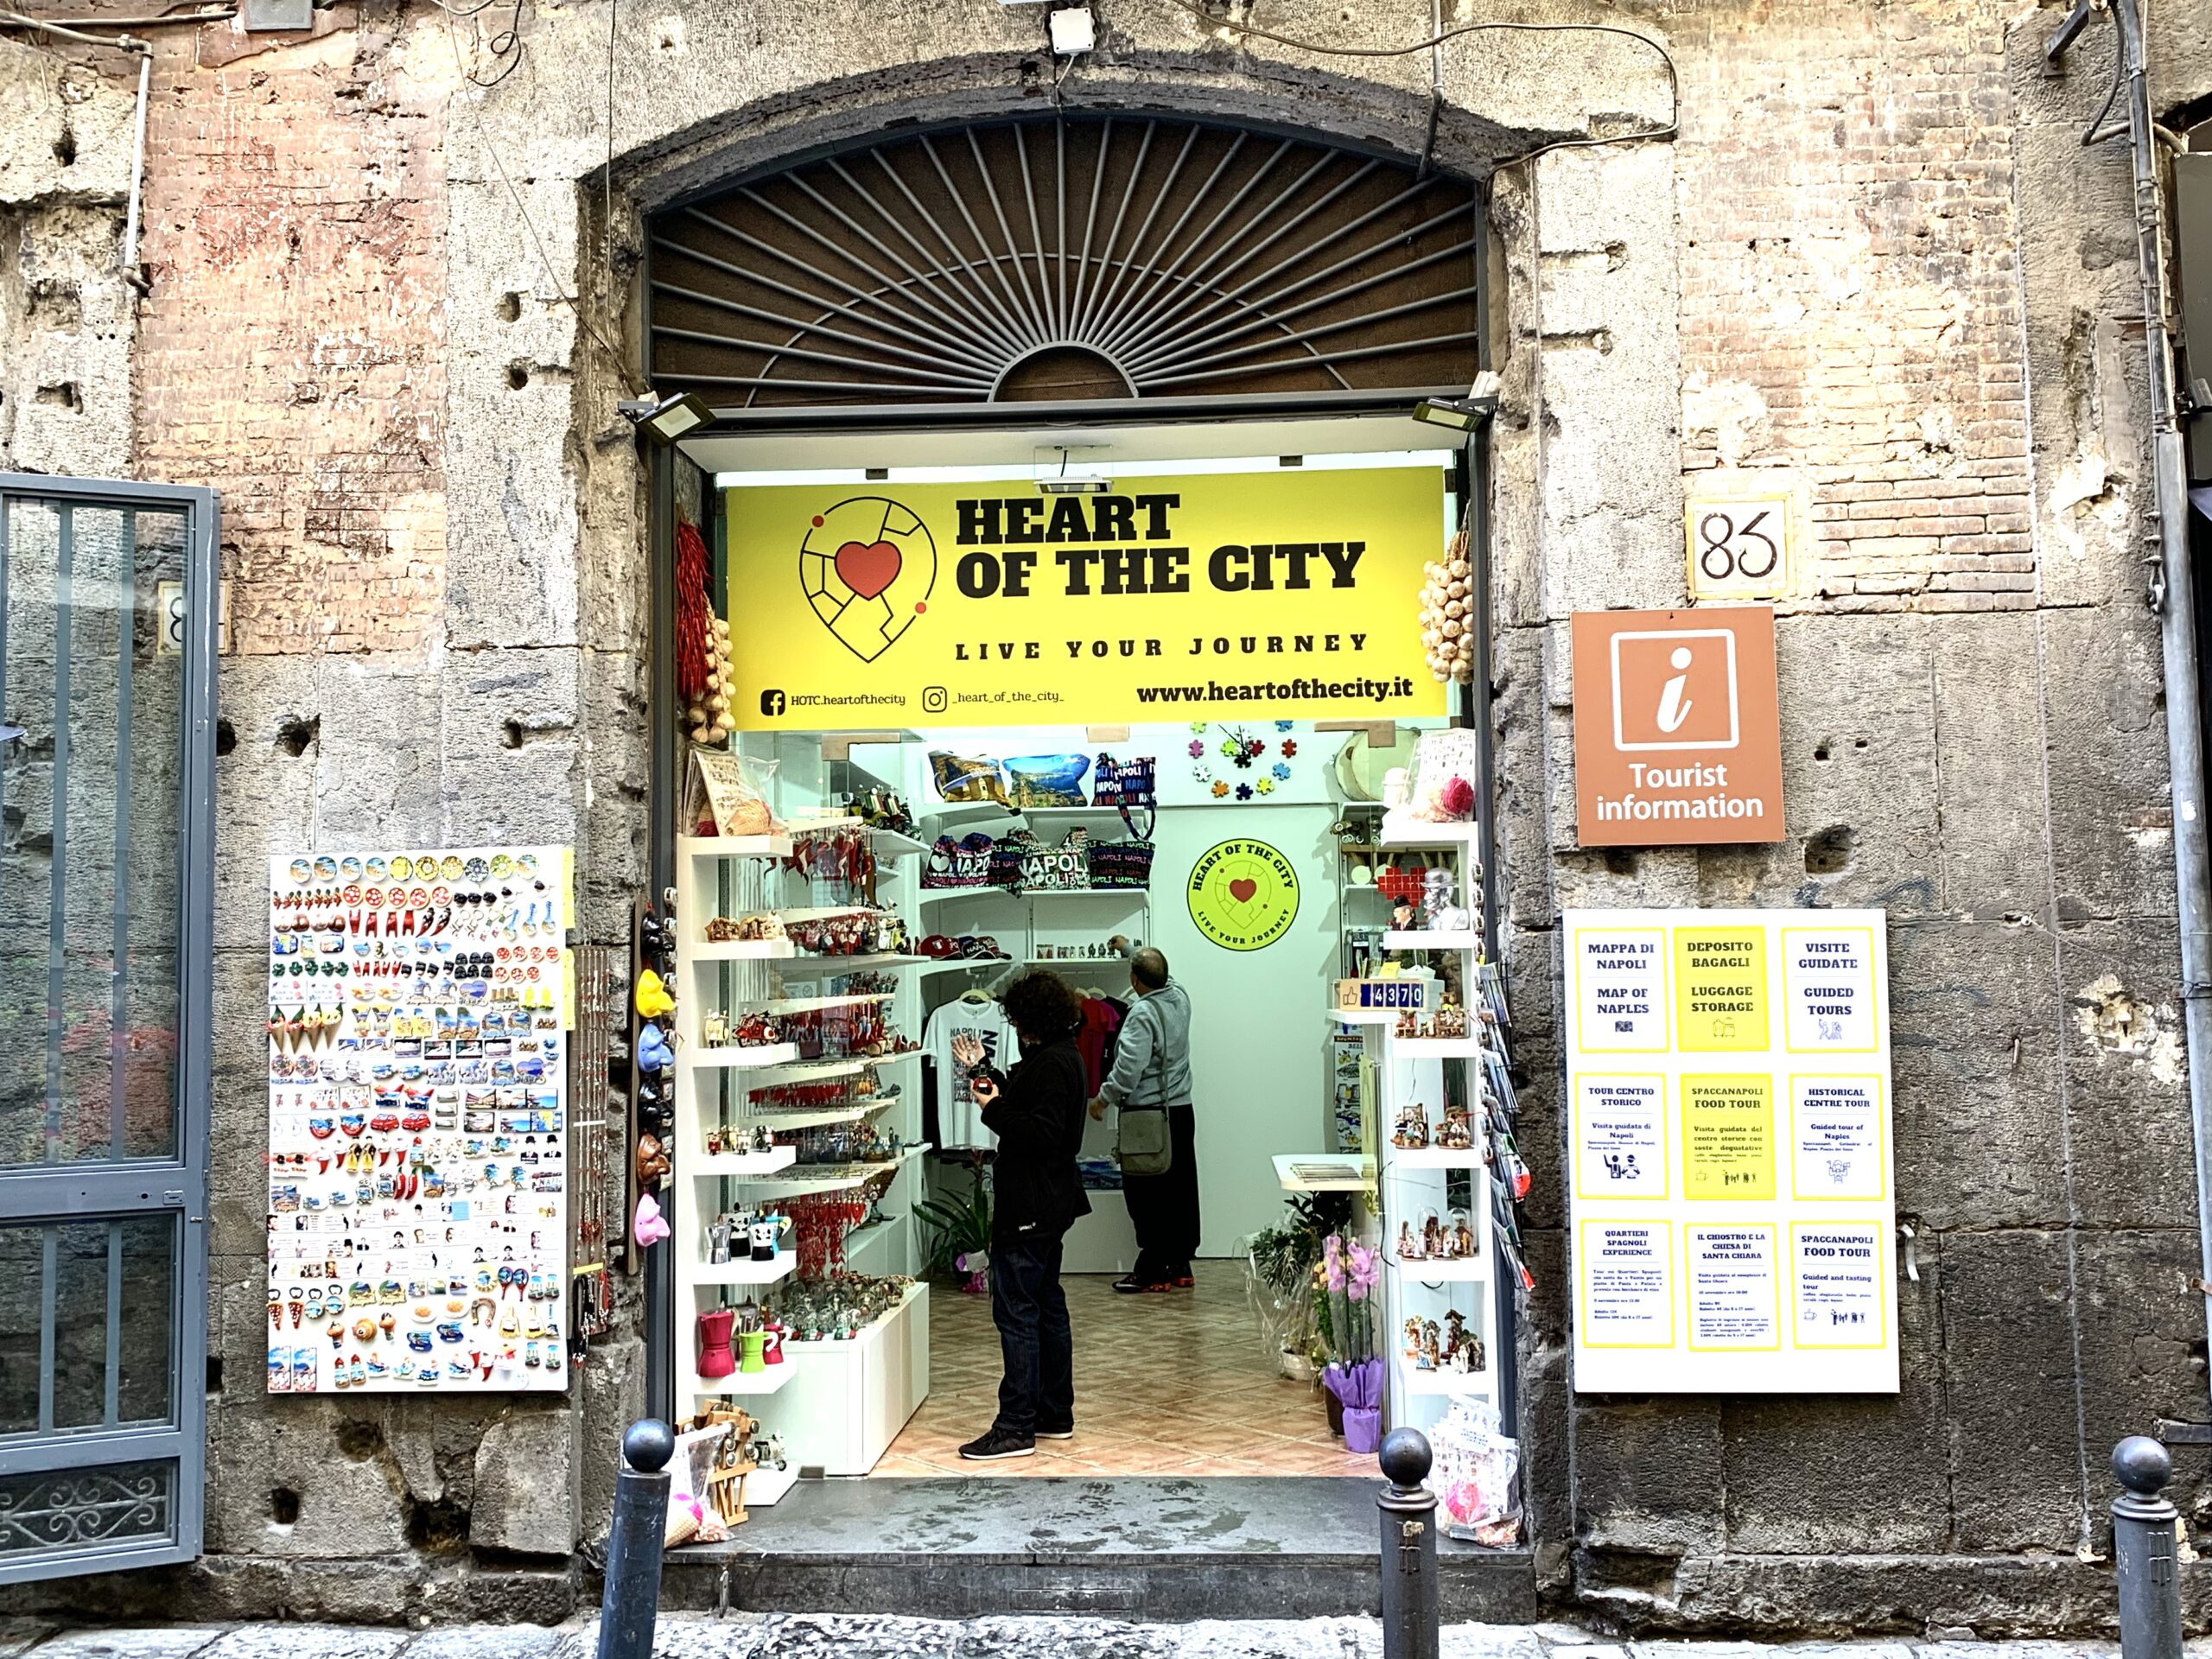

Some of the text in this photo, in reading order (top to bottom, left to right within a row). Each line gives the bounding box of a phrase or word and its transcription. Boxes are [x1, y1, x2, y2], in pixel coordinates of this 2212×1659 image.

[957, 493, 1180, 544] HEART
[957, 542, 1365, 598] OF THE CITY
[957, 634, 1366, 660] LIVE YOUR JOURNEY
[1137, 677, 1413, 702] www.heartofthecity.it
[791, 695, 905, 706] HOTC.heartofthecity
[1629, 762, 1727, 788] Tourist
[1598, 793, 1763, 820] information
[1192, 844, 1294, 891] HEART OF THE CITY
[1198, 909, 1289, 944] LIVE YOUR JOURNEY
[1589, 944, 1654, 953] MAPPA DI
[1688, 943, 1752, 951] DEPOSITO
[1806, 944, 1849, 952] VISITE
[1597, 960, 1646, 969] NAPOLI
[1693, 958, 1749, 967] BAGAGLI
[1799, 959, 1857, 968] GUIDATE
[1598, 988, 1648, 997] MAP OF
[1692, 987, 1752, 995] LUGGAGE
[1804, 988, 1853, 997] GUIDED
[1598, 1005, 1649, 1014] NAPLES
[1692, 1002, 1753, 1012] STORAGE
[1808, 1006, 1852, 1014] TOURS
[1804, 1248, 1835, 1256] FOOD
